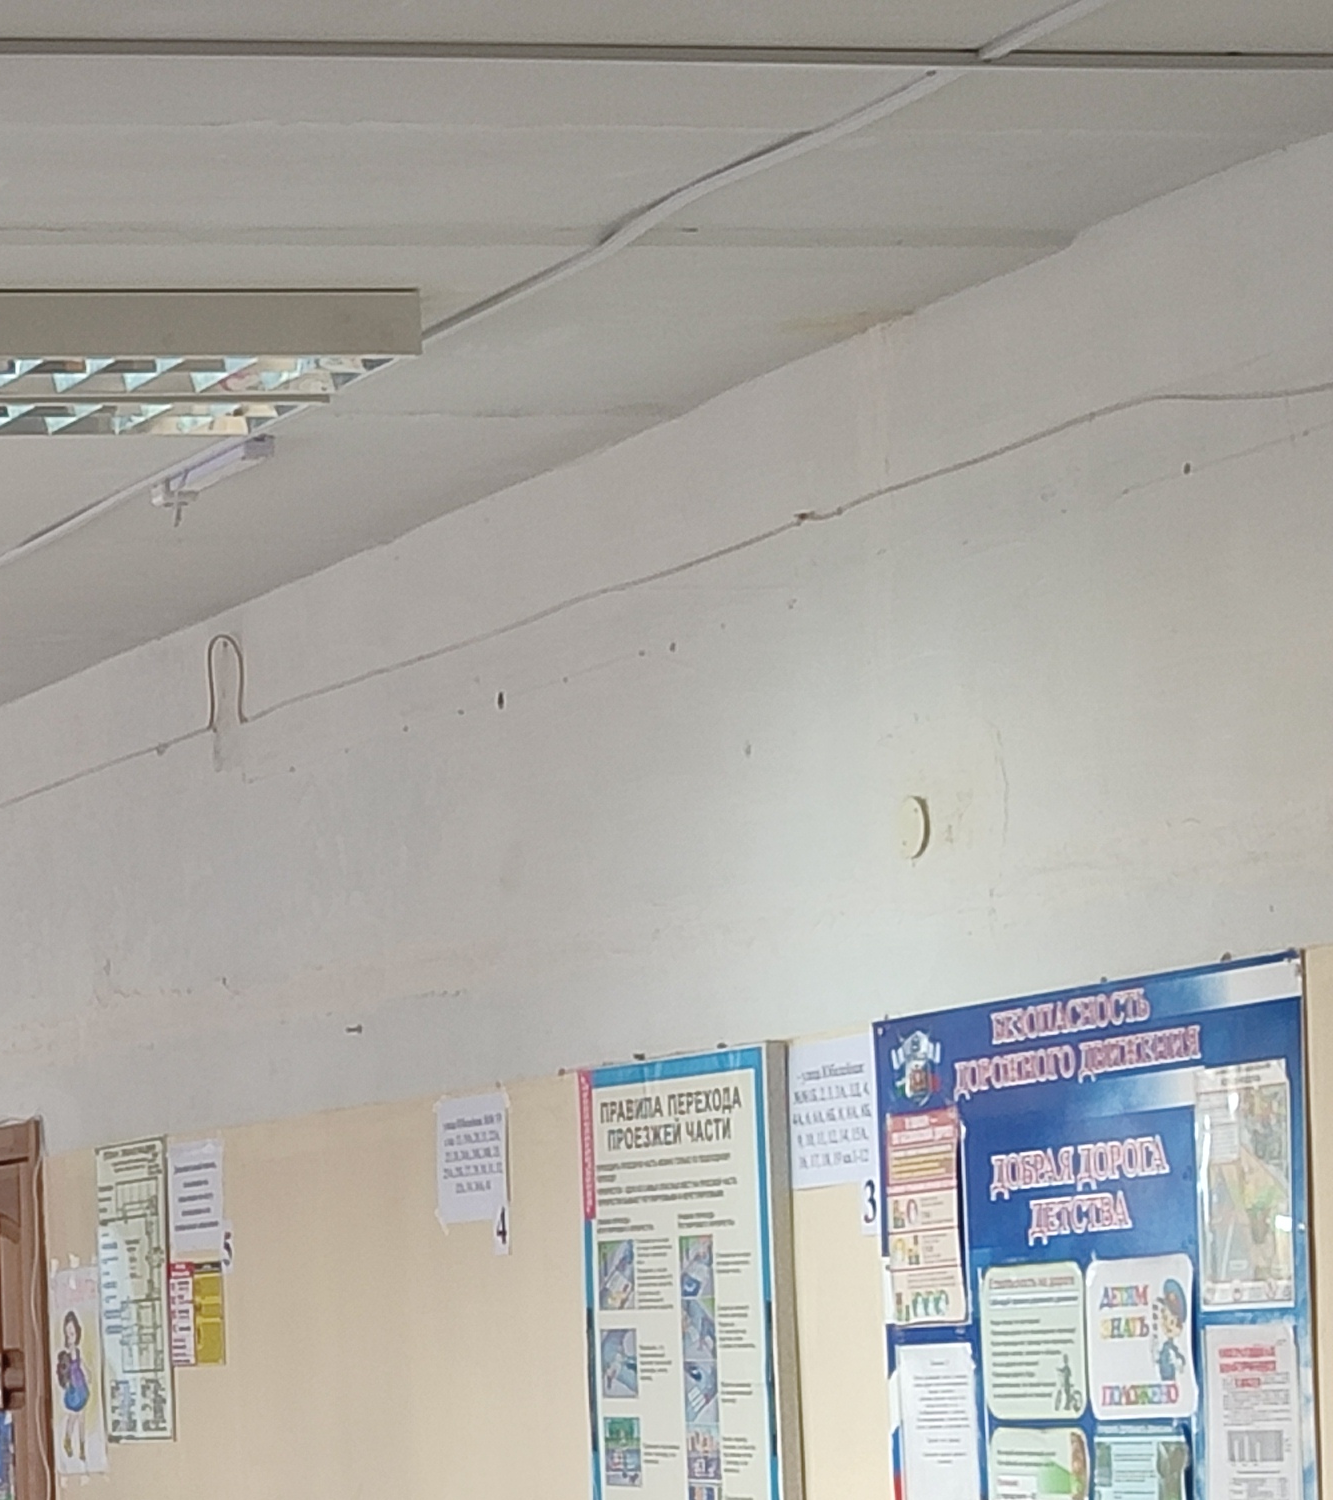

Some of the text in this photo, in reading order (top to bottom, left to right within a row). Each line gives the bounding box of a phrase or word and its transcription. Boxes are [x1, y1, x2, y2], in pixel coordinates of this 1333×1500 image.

[990, 988, 1150, 1045] БЕЗОПАСНОСТЬ
[953, 1044, 1076, 1101] ДОРОЖНОГО
[1078, 1025, 1202, 1083] ДВИЖЕНИЯ
[600, 1086, 742, 1124] ПРАВИЛА ПЕРЕХОДА
[607, 1117, 732, 1151] ПРОЕЗЖЕЙ ЧАСТИ
[990, 1145, 1075, 1201] ДОБРАЯ
[1076, 1135, 1170, 1191] ДОРОГА
[863, 1179, 877, 1223] 3
[1028, 1190, 1133, 1246] ДЕТСТВА
[496, 1206, 507, 1245] 4
[1100, 1315, 1149, 1339] ЗНАТЬ
